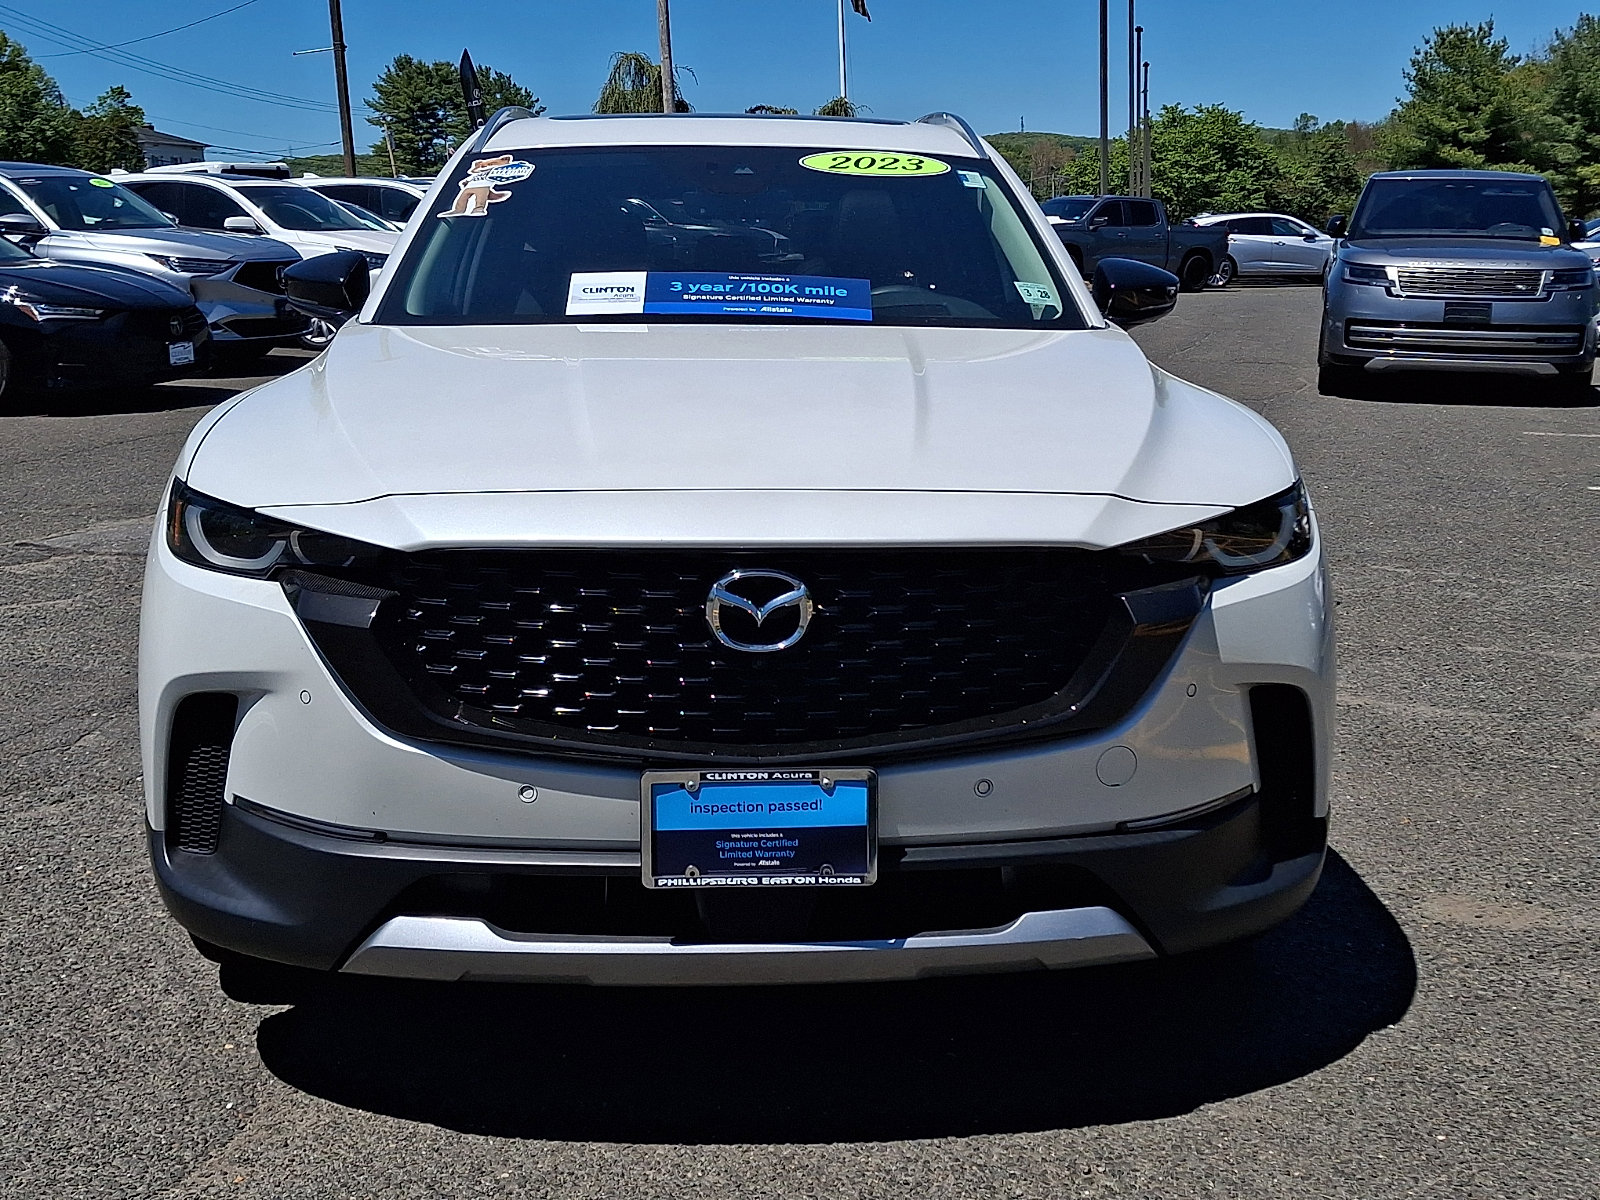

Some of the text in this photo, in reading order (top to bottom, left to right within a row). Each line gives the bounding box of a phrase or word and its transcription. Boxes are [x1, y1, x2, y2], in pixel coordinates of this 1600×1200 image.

[828, 155, 925, 171] 2023
[582, 286, 635, 294] CLINTON
[669, 281, 848, 297] 3 year /100K mile
[1023, 288, 1033, 297] 3
[797, 297, 835, 305] Warranty
[706, 772, 769, 780] CLINTON
[690, 799, 823, 815] inspection passed!
[715, 839, 799, 849] Signature Certified
[719, 849, 796, 859] Limited Warranty
[657, 876, 862, 886] PHILLIPSBURG EASTON Honda
